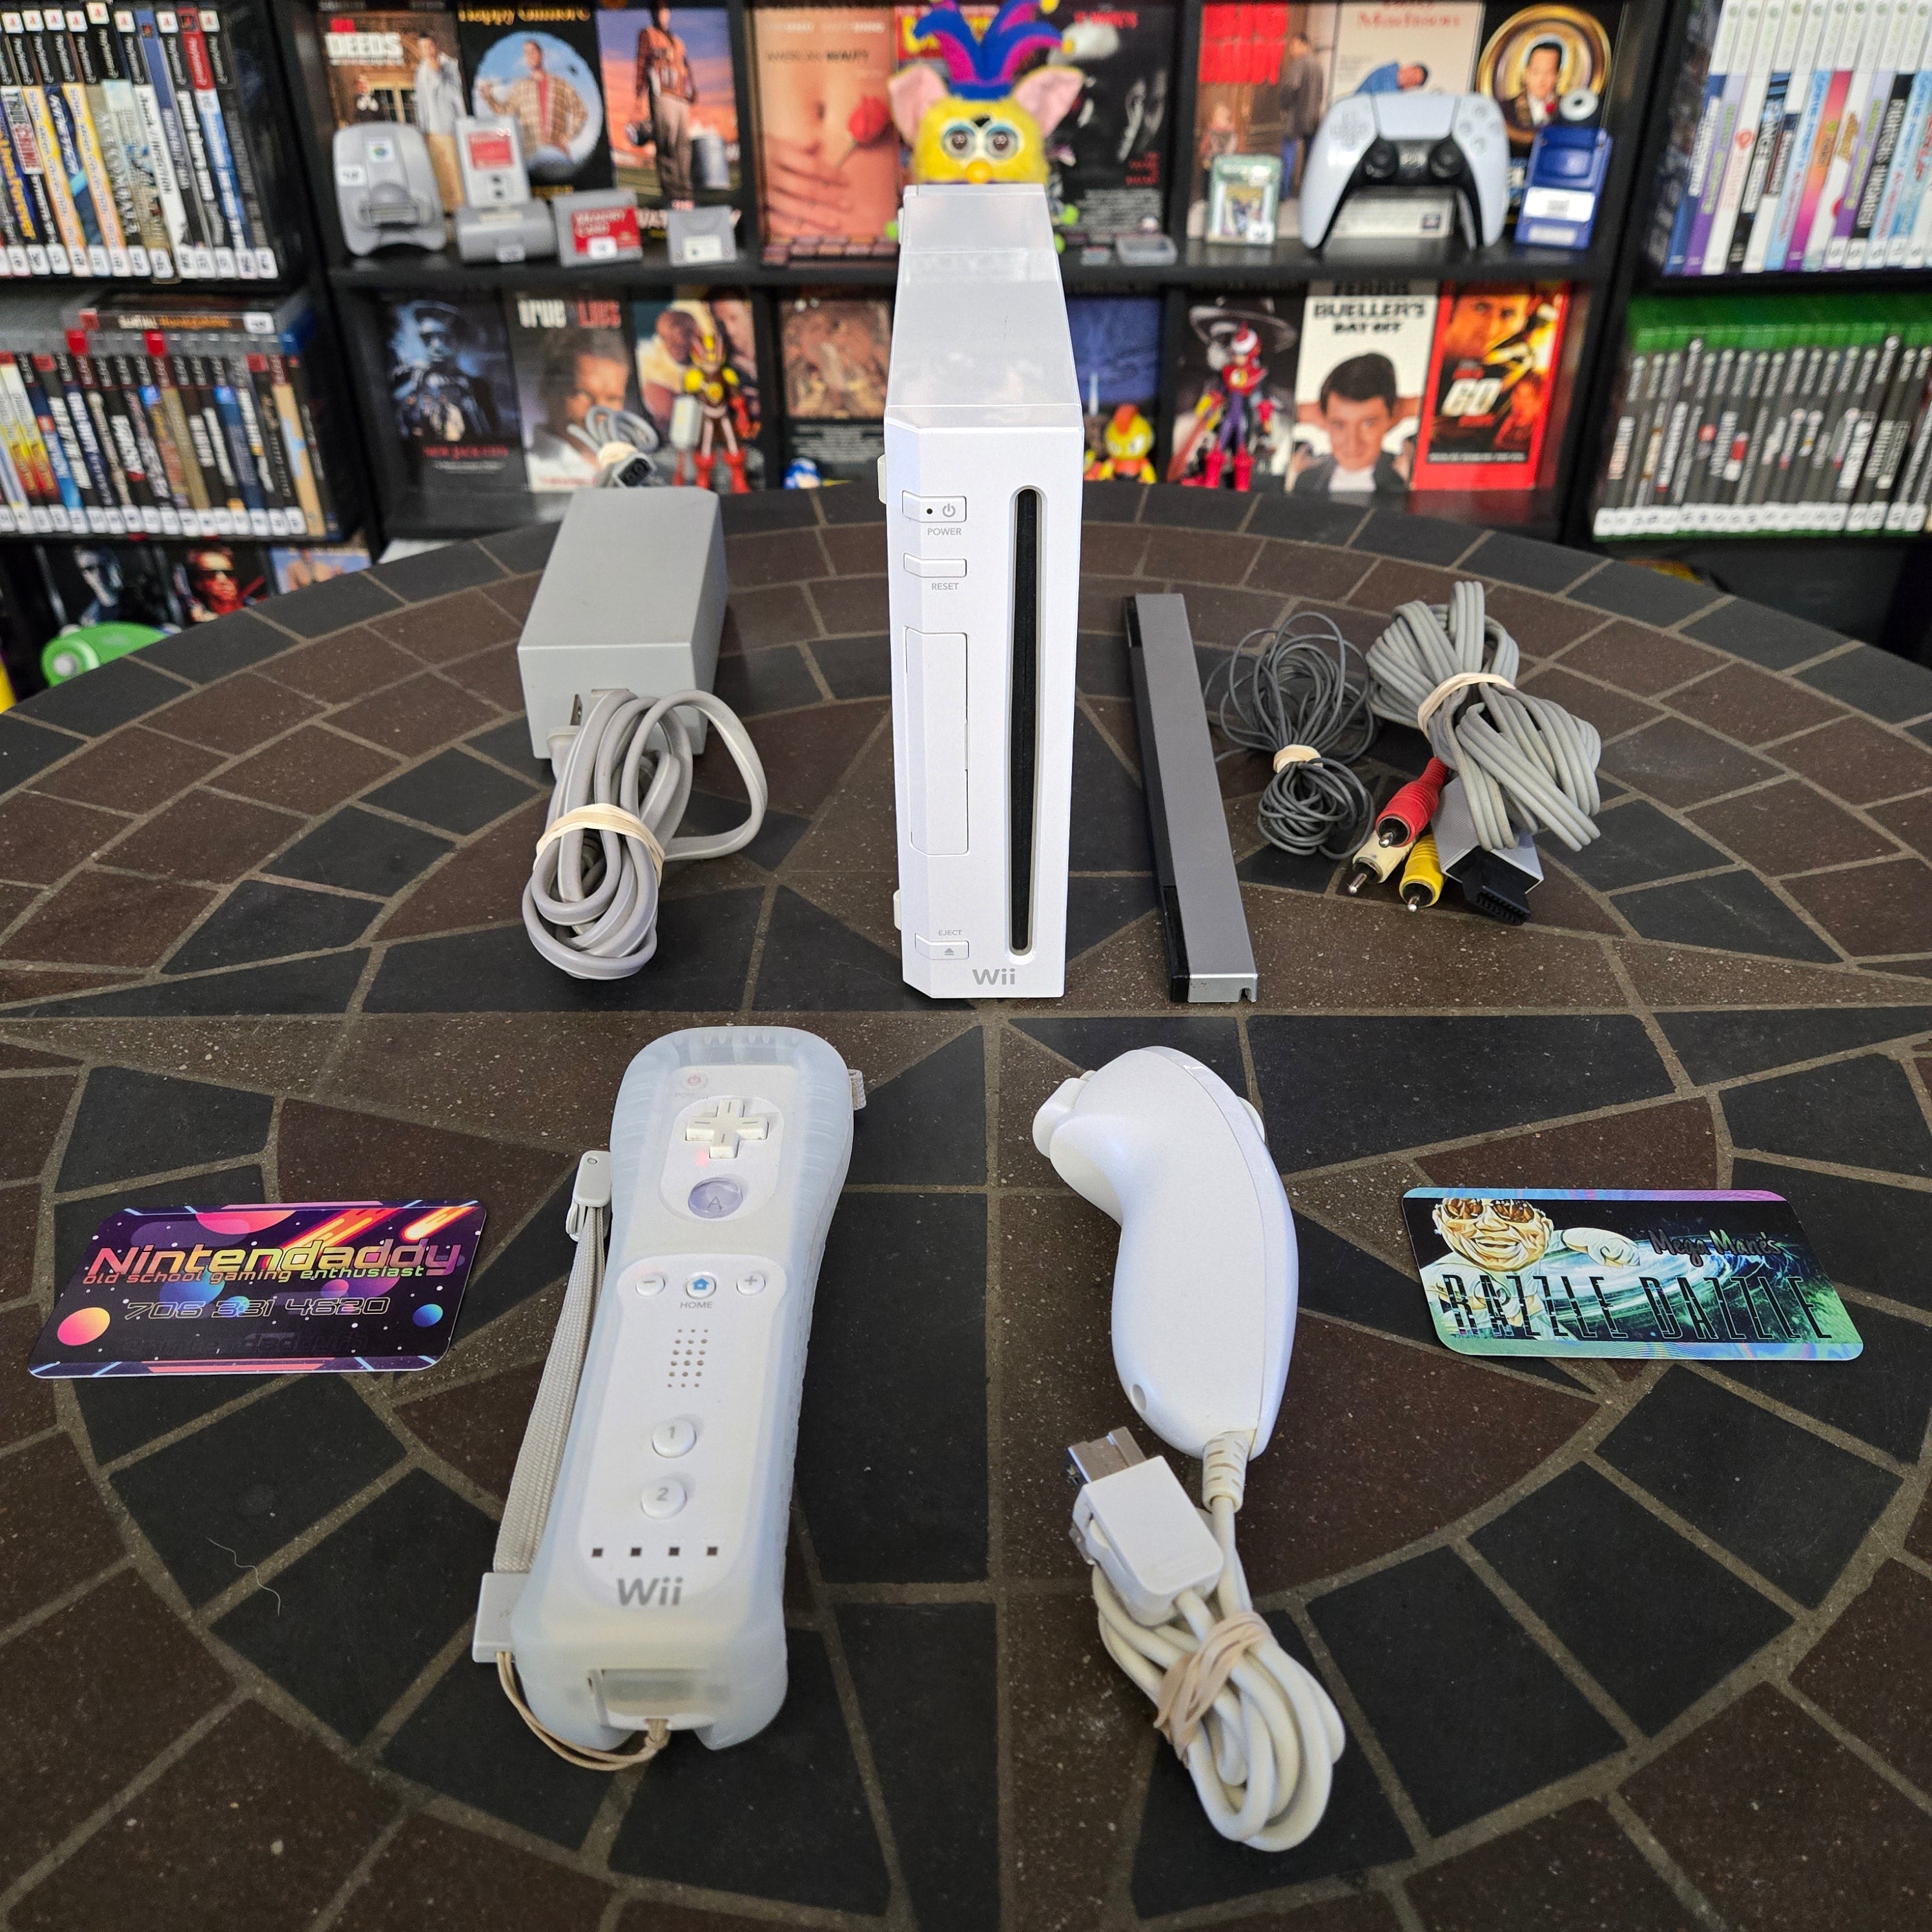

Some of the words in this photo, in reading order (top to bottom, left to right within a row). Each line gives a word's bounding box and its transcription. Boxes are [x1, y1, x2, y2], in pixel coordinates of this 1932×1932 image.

[972, 968, 1016, 985] Wii
[87, 1238, 462, 1277] Nintendaddy
[1647, 1229, 1711, 1267] Mega
[83, 1271, 122, 1285] old
[126, 1269, 203, 1284] school
[209, 1269, 292, 1284] gaming
[300, 1265, 424, 1280] enthusiast
[124, 1300, 207, 1321] 706
[285, 1297, 391, 1316] 4620
[1442, 1274, 1629, 1339] RAZZLE
[1638, 1275, 1833, 1339] DAZZLE
[657, 1487, 670, 1501] 2
[617, 1576, 684, 1607] Wii
